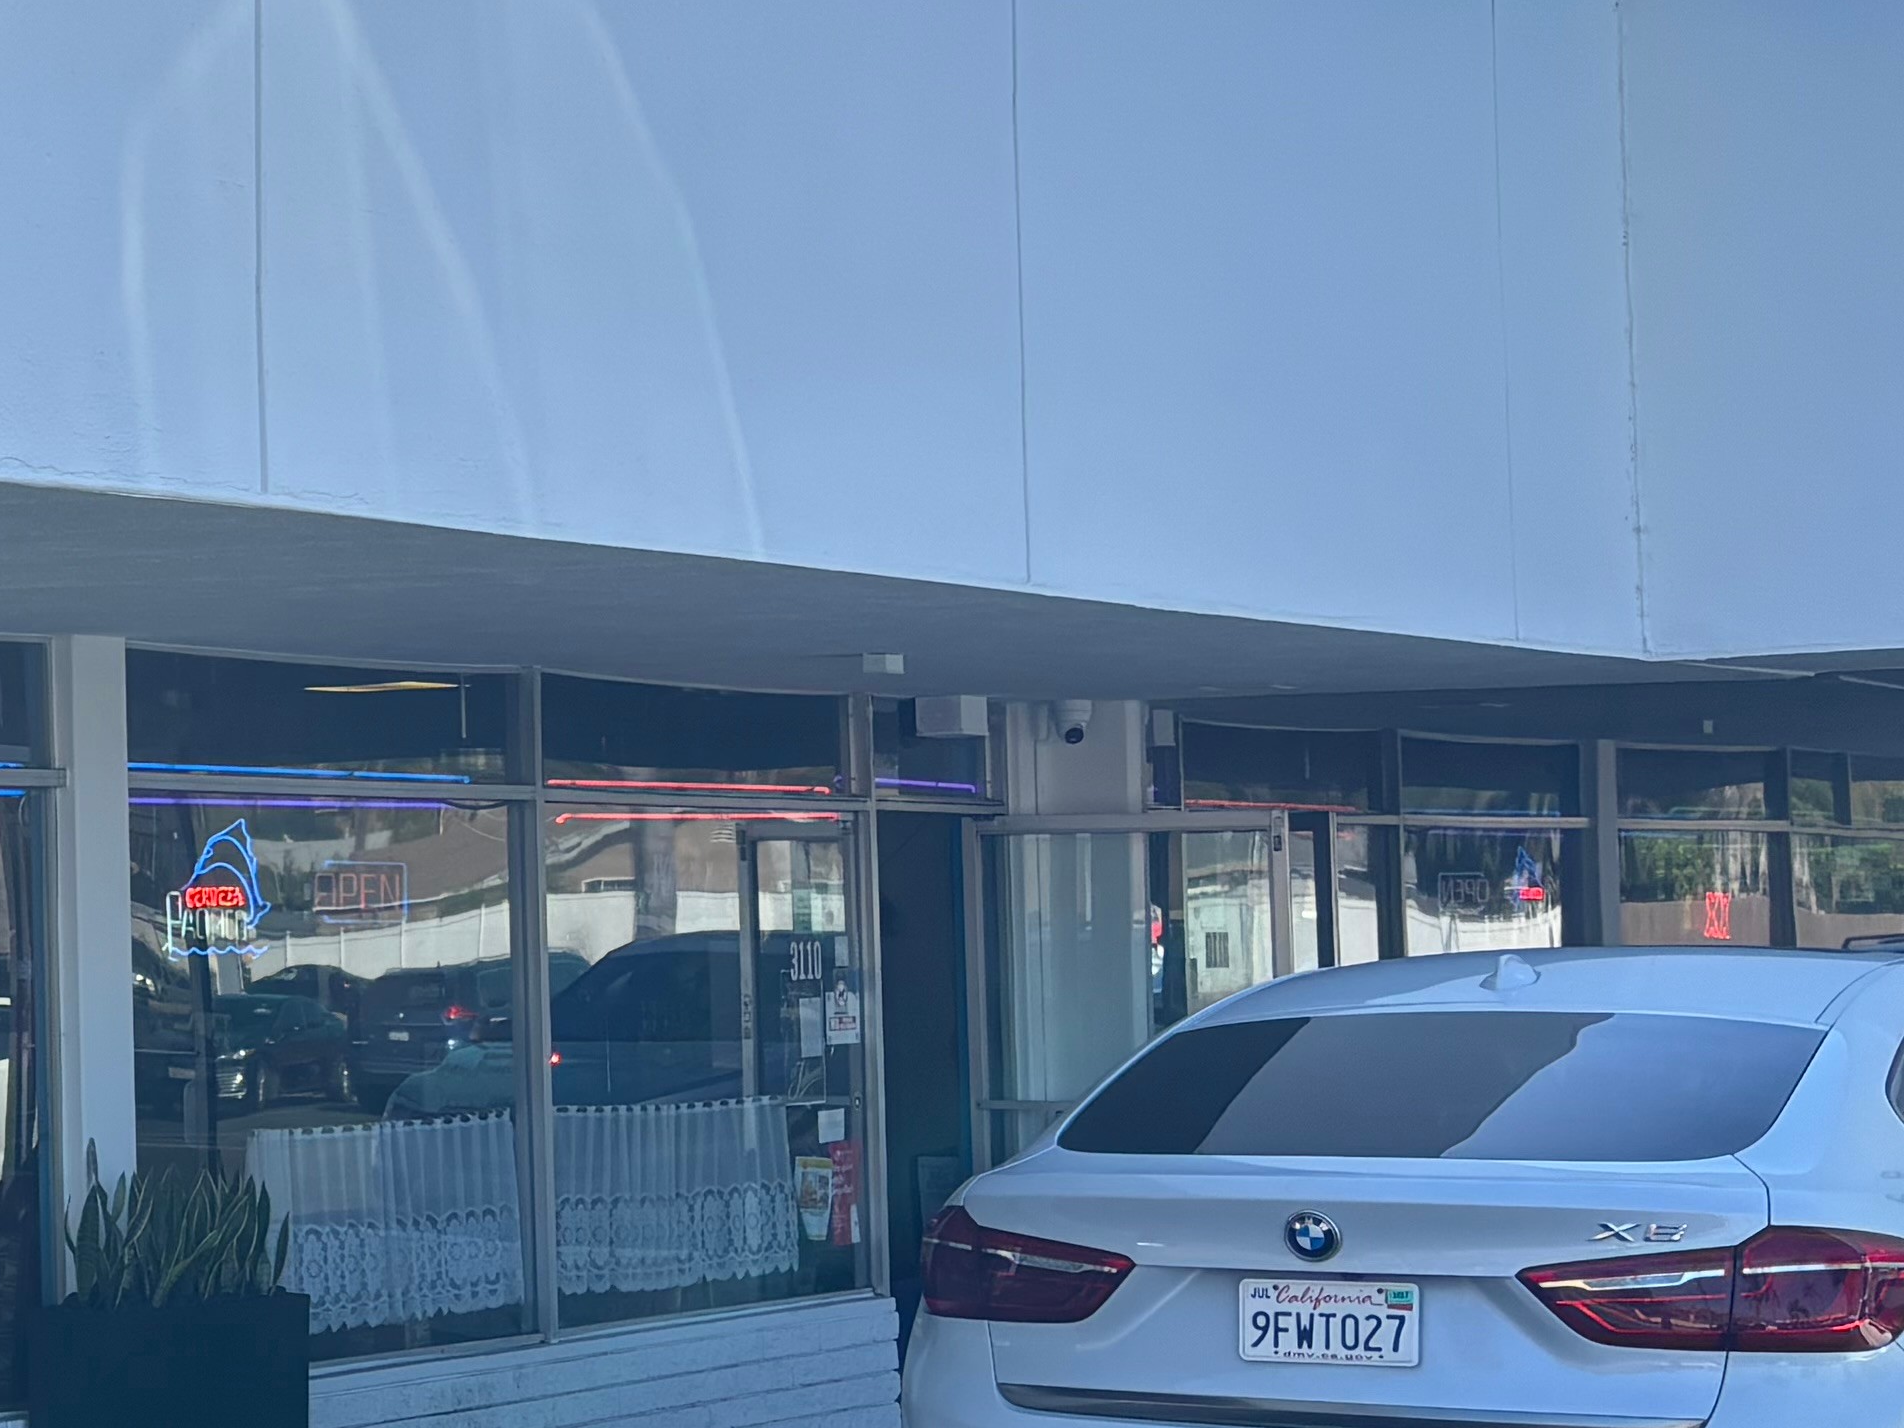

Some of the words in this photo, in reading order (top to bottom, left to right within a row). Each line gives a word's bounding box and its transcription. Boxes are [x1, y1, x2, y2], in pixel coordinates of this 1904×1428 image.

[185, 886, 248, 908] CERVEZA
[315, 873, 401, 911] OPEN
[790, 940, 823, 982] 3110
[1250, 1286, 1272, 1300] JUL
[1275, 1283, 1384, 1311] California
[1250, 1310, 1406, 1353] 9FWT027
